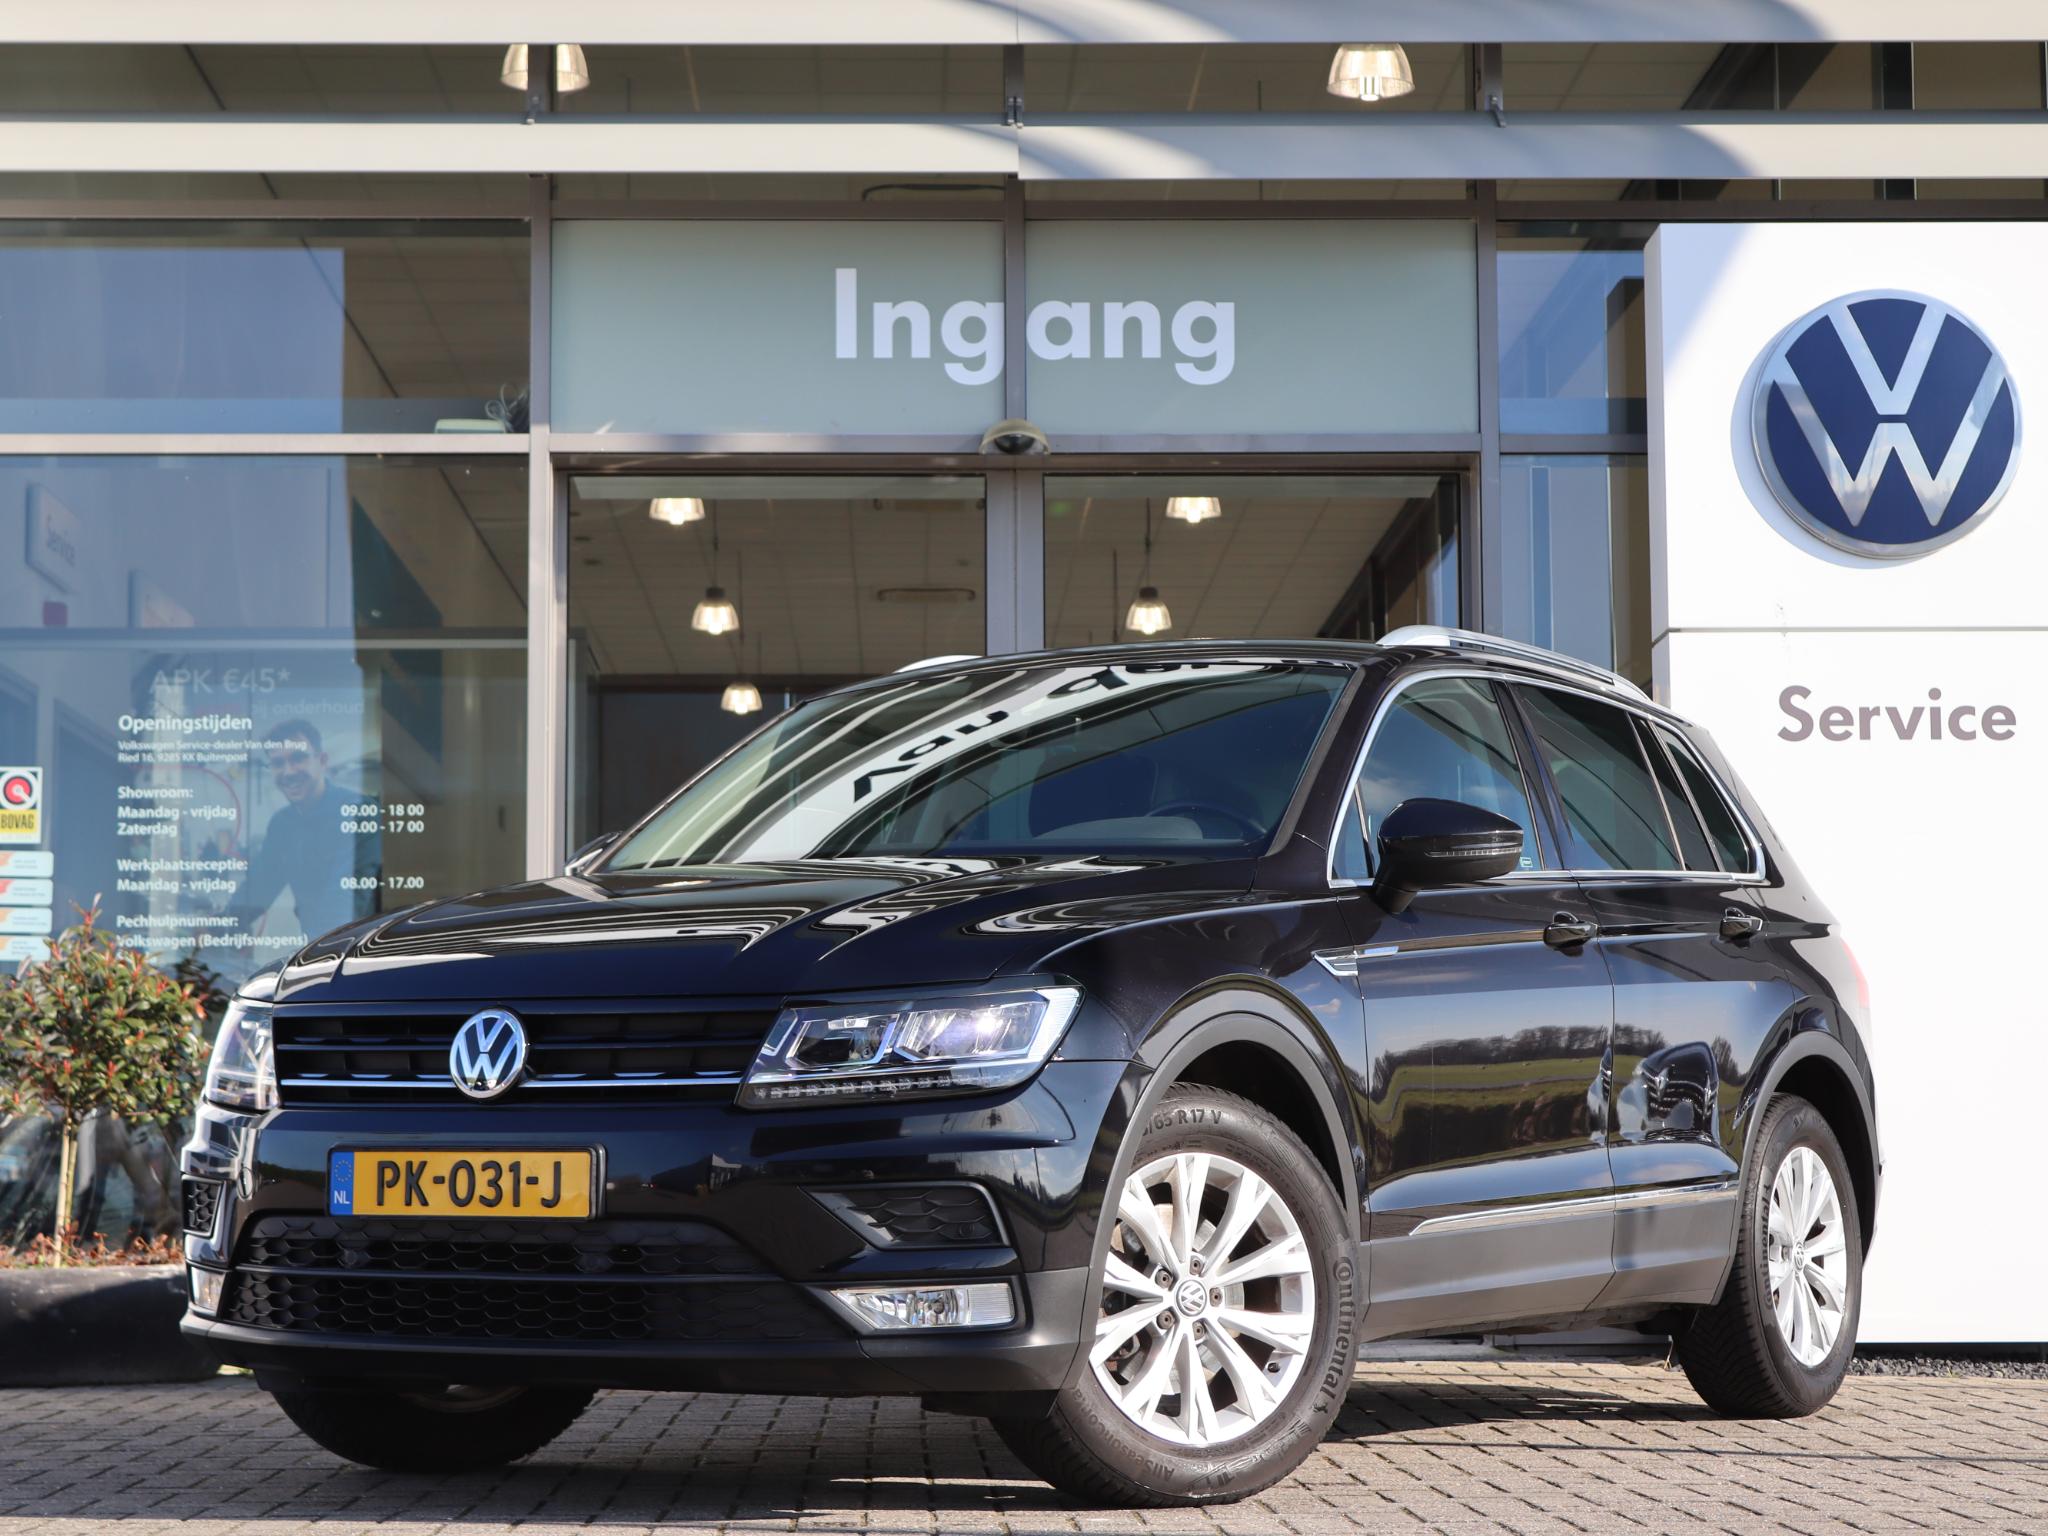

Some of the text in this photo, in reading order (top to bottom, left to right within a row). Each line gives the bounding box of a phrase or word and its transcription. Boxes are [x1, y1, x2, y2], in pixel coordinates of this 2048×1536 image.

[835, 267, 1236, 386] Ingang
[149, 668, 214, 694] APK
[1777, 684, 2018, 742] Service
[118, 714, 253, 734] Openingstijden
[117, 740, 175, 752] Volkswagen
[245, 740, 262, 751] Van
[117, 786, 194, 799] Showroom:
[117, 806, 180, 821] Maandag
[190, 805, 237, 821] vrijdag
[340, 804, 378, 817] 09.00
[1, 813, 34, 829] BOVAG
[340, 820, 378, 833] 09.00
[117, 822, 178, 838] Zaterdag
[117, 858, 249, 874] Werkplaatsreceptie:
[117, 878, 180, 893] Maandag
[190, 878, 237, 894] vrijdag
[340, 877, 378, 890] 08.00
[388, 876, 425, 890] 17.00
[116, 914, 239, 930] Pechhulpnummer:
[116, 933, 309, 950] Volkswagen (Bedrijfswagens)
[376, 1159, 562, 1208] PK-031-J
[333, 1190, 351, 1205] NL
[1318, 1256, 1356, 1400] Continental
